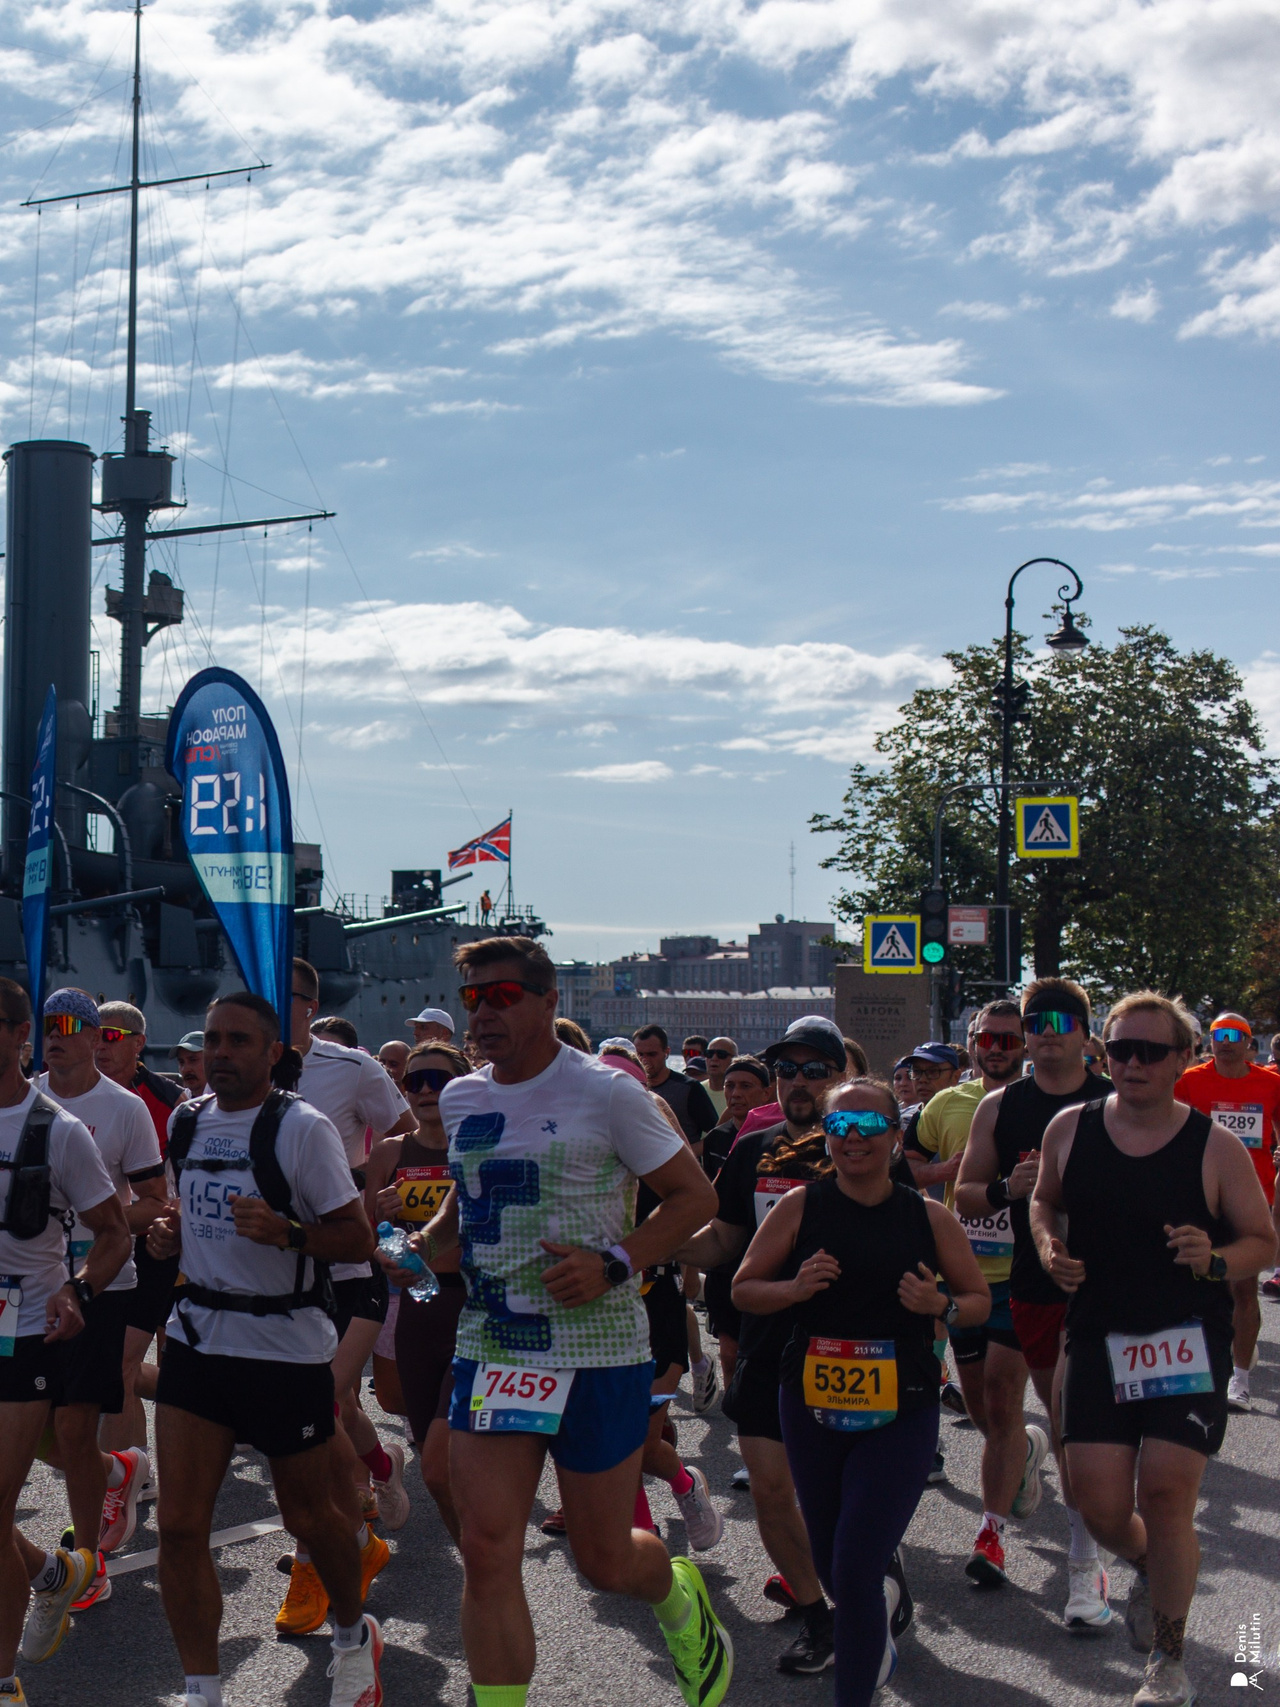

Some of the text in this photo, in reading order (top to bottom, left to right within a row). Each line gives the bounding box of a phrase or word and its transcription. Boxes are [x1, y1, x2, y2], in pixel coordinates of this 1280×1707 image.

[856, 1005, 900, 1016] АВРОРА
[966, 1229, 998, 1239] ЕВГЕНИЙ
[854, 1346, 869, 1355] 21,1
[870, 1347, 883, 1355] КМ
[1122, 1339, 1194, 1373] 7016
[814, 1364, 880, 1395] 5321
[485, 1370, 558, 1402] 7459
[1129, 1383, 1140, 1397] E
[472, 1398, 483, 1407] VIP
[827, 1395, 870, 1406] ЭЛЬМИРА
[479, 1412, 488, 1427] E
